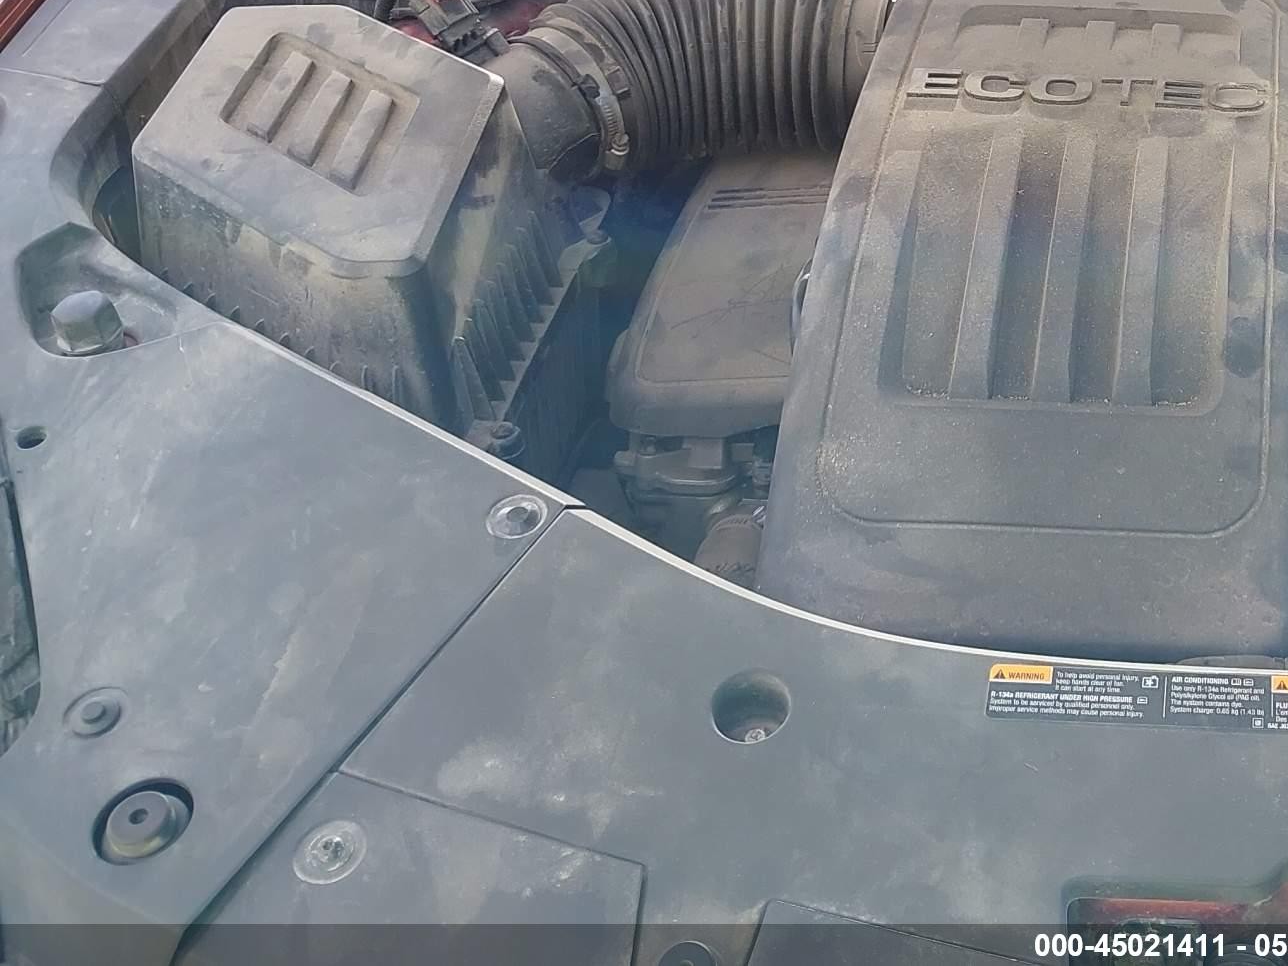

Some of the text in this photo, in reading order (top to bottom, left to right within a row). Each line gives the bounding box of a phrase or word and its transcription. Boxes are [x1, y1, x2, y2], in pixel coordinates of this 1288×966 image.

[904, 68, 1269, 113] ECOTEC
[1009, 672, 1045, 680] WARNING
[1064, 672, 1078, 680] help
[1184, 677, 1229, 685] CONDITIONING
[1220, 686, 1252, 694] Refrigerant
[991, 690, 1014, 698] R-134a
[1015, 692, 1058, 700] REFRIGERANT
[1170, 692, 1207, 700] Polyalkylene
[1235, 694, 1250, 702] (PAG
[990, 698, 1012, 706] System
[1064, 701, 1089, 709] qualified
[1231, 708, 1238, 716] kg
